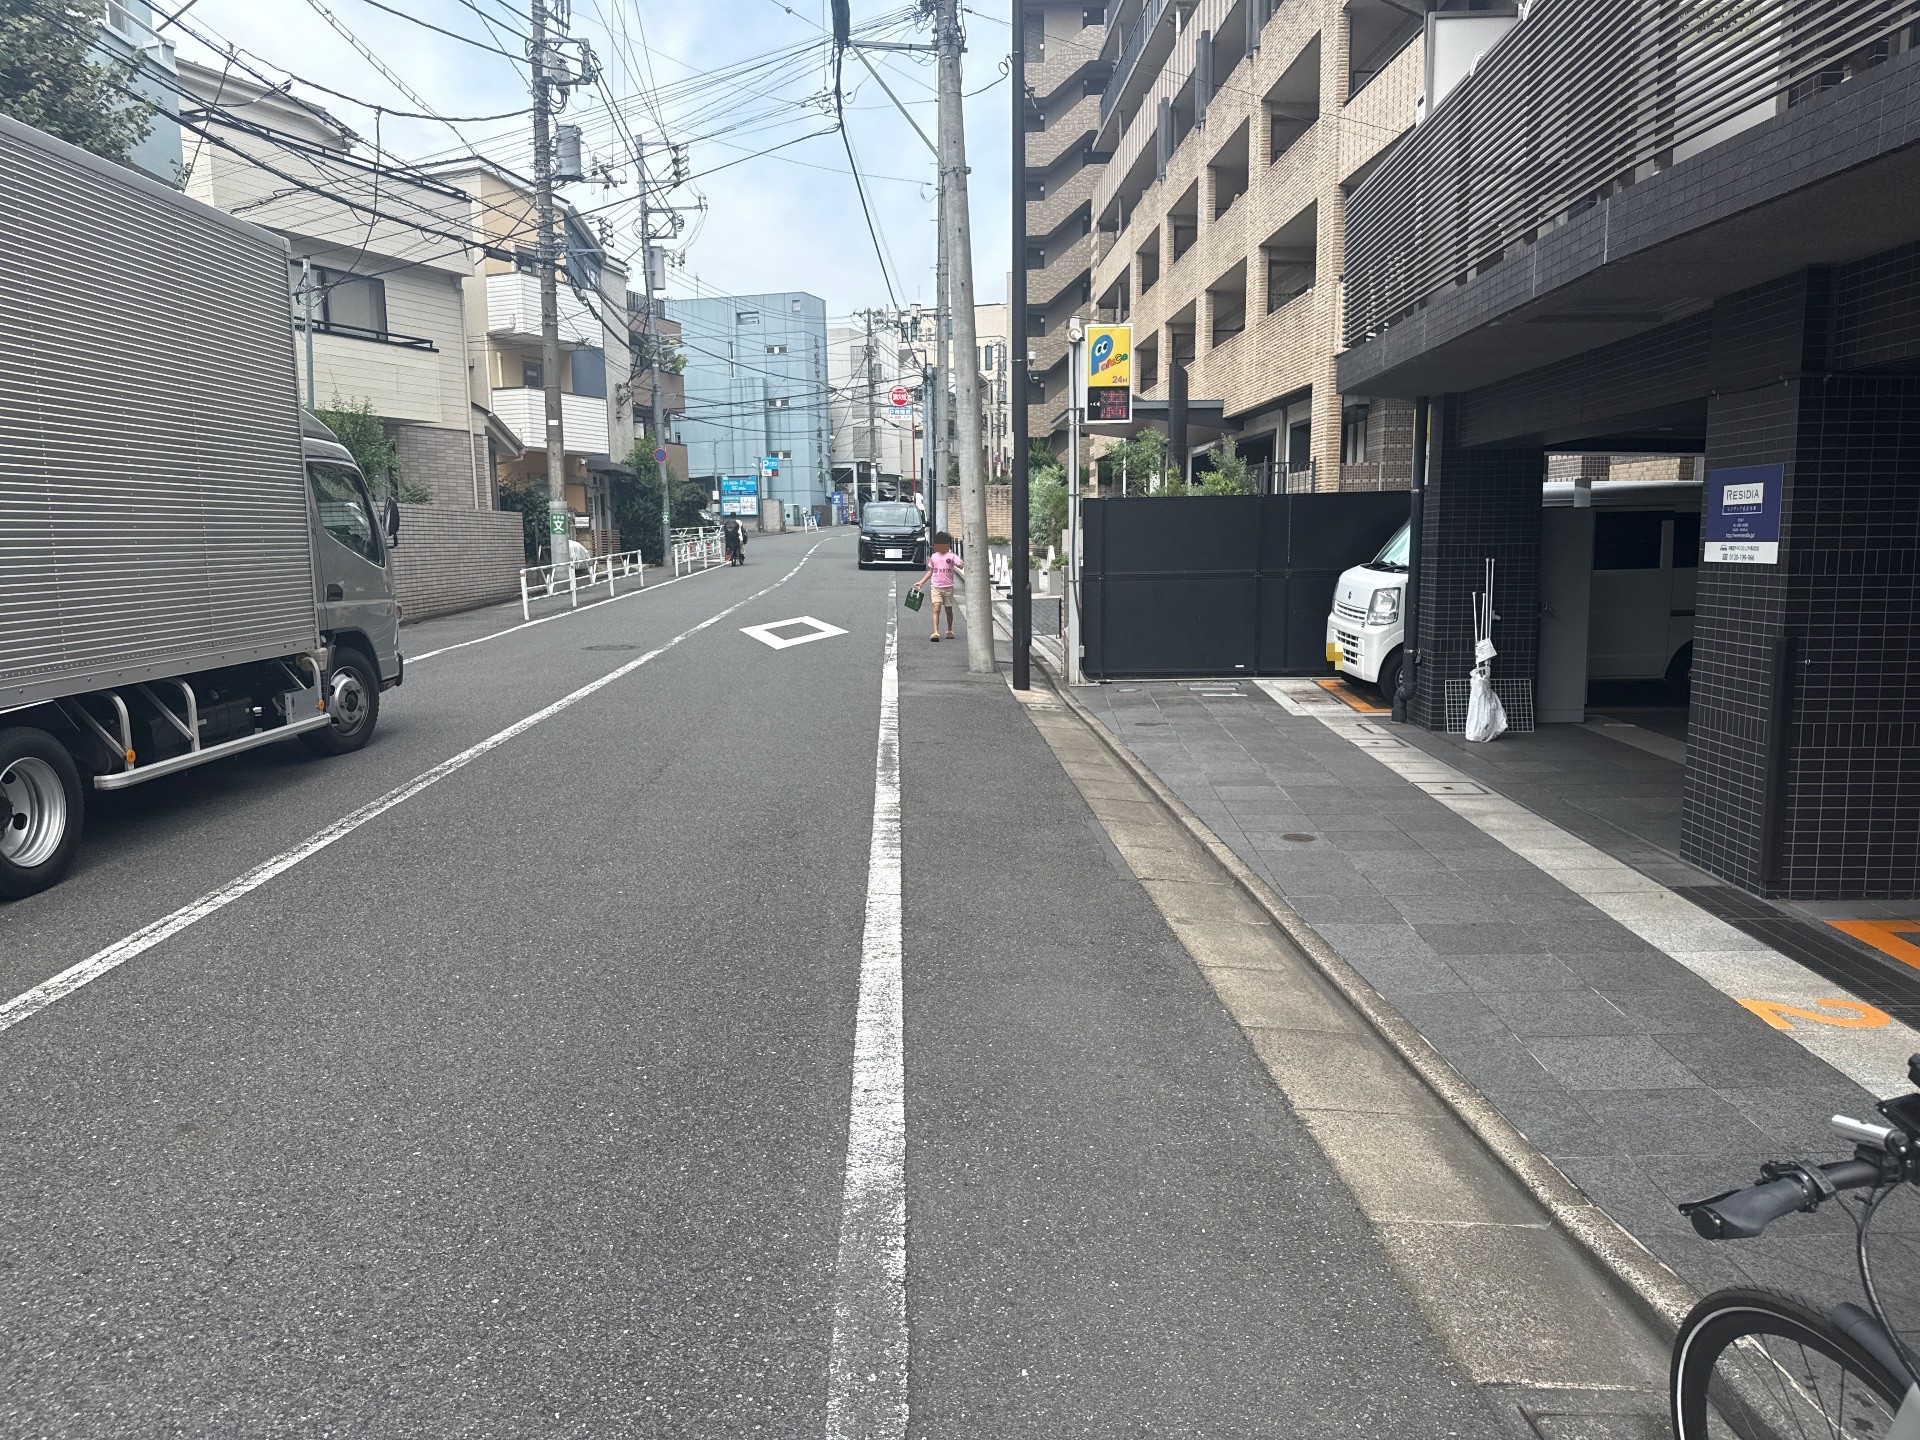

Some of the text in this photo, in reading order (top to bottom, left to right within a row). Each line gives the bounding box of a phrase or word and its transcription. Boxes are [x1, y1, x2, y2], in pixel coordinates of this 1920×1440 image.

[1726, 489, 1760, 500] RESIDIA
[552, 520, 565, 531] 文
[1736, 998, 1891, 1030] 2
